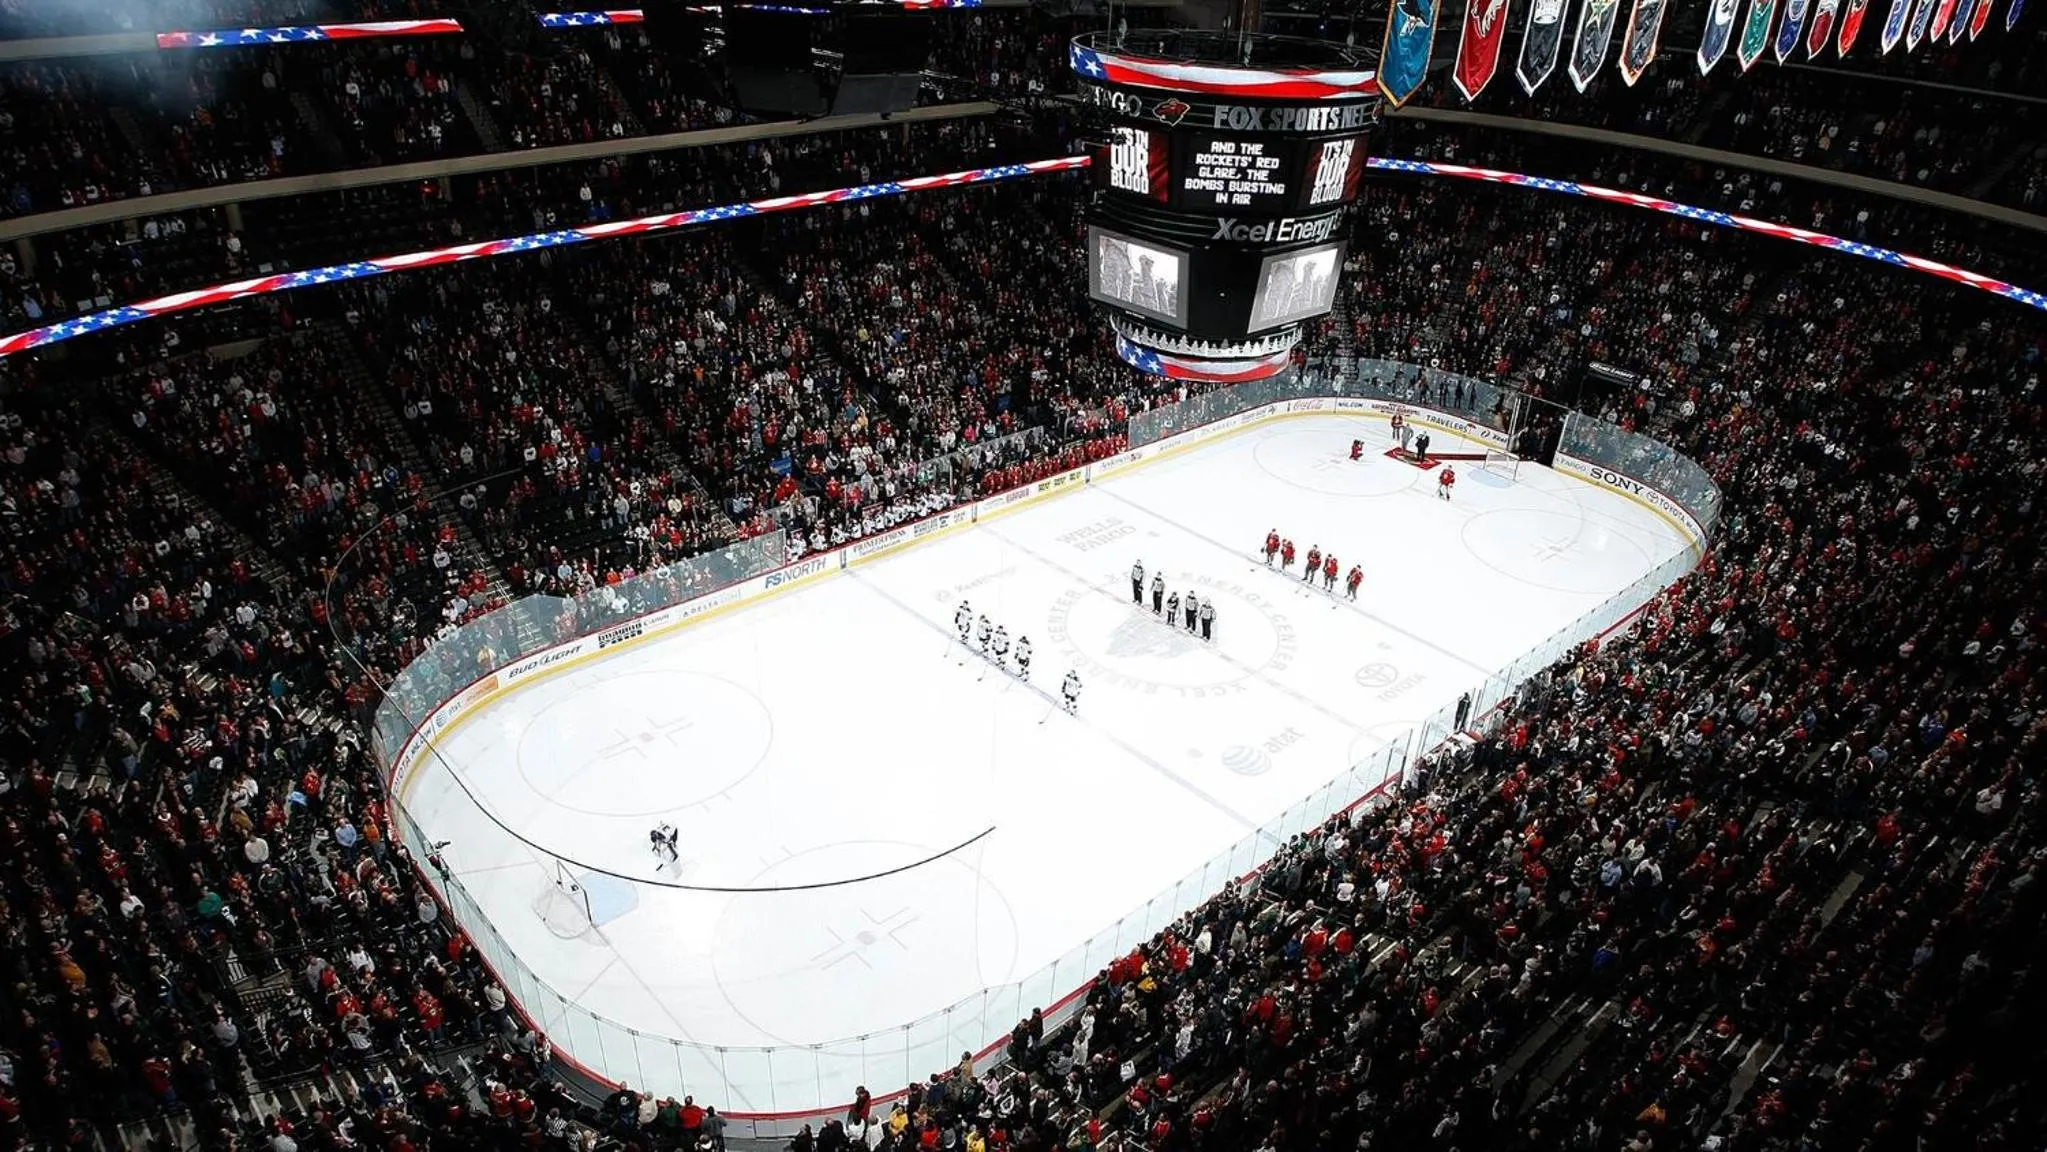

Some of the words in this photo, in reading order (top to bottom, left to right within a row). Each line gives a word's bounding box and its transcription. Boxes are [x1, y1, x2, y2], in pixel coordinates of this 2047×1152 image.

[1214, 105, 1263, 130] FOX
[1269, 107, 1341, 131] SPORTS
[1110, 144, 1149, 176] OUR
[1196, 153, 1252, 167] ROCKETS'
[1256, 157, 1280, 169] RED
[1211, 141, 1236, 153] AND
[1240, 143, 1264, 155] THE
[1110, 169, 1149, 194] BLOOD
[1199, 166, 1242, 179] GLARE,
[1246, 169, 1270, 181] THE
[1314, 155, 1351, 186] OUR
[1185, 178, 1225, 191] BOMBS
[1228, 180, 1285, 195] BURSTING
[1215, 192, 1228, 204] IN
[1232, 193, 1252, 205] AIR
[1309, 185, 1344, 204] BLOOD
[1212, 218, 1275, 242] Xcel
[1276, 216, 1335, 243] Energy
[1426, 414, 1468, 433] TRAVELERS
[1590, 467, 1644, 495] SONY
[1659, 498, 1688, 524] TOYOTA
[1056, 517, 1124, 543] WELLS
[1073, 525, 1136, 552] FARGO
[1047, 588, 1083, 643] CENTER
[1269, 611, 1298, 671] CENTER
[509, 662, 538, 679] BUD
[543, 645, 583, 665] LIGHT
[1179, 682, 1247, 698] XCEL
[1376, 672, 1427, 702] TOYOTA
[1264, 727, 1305, 754] at&t
